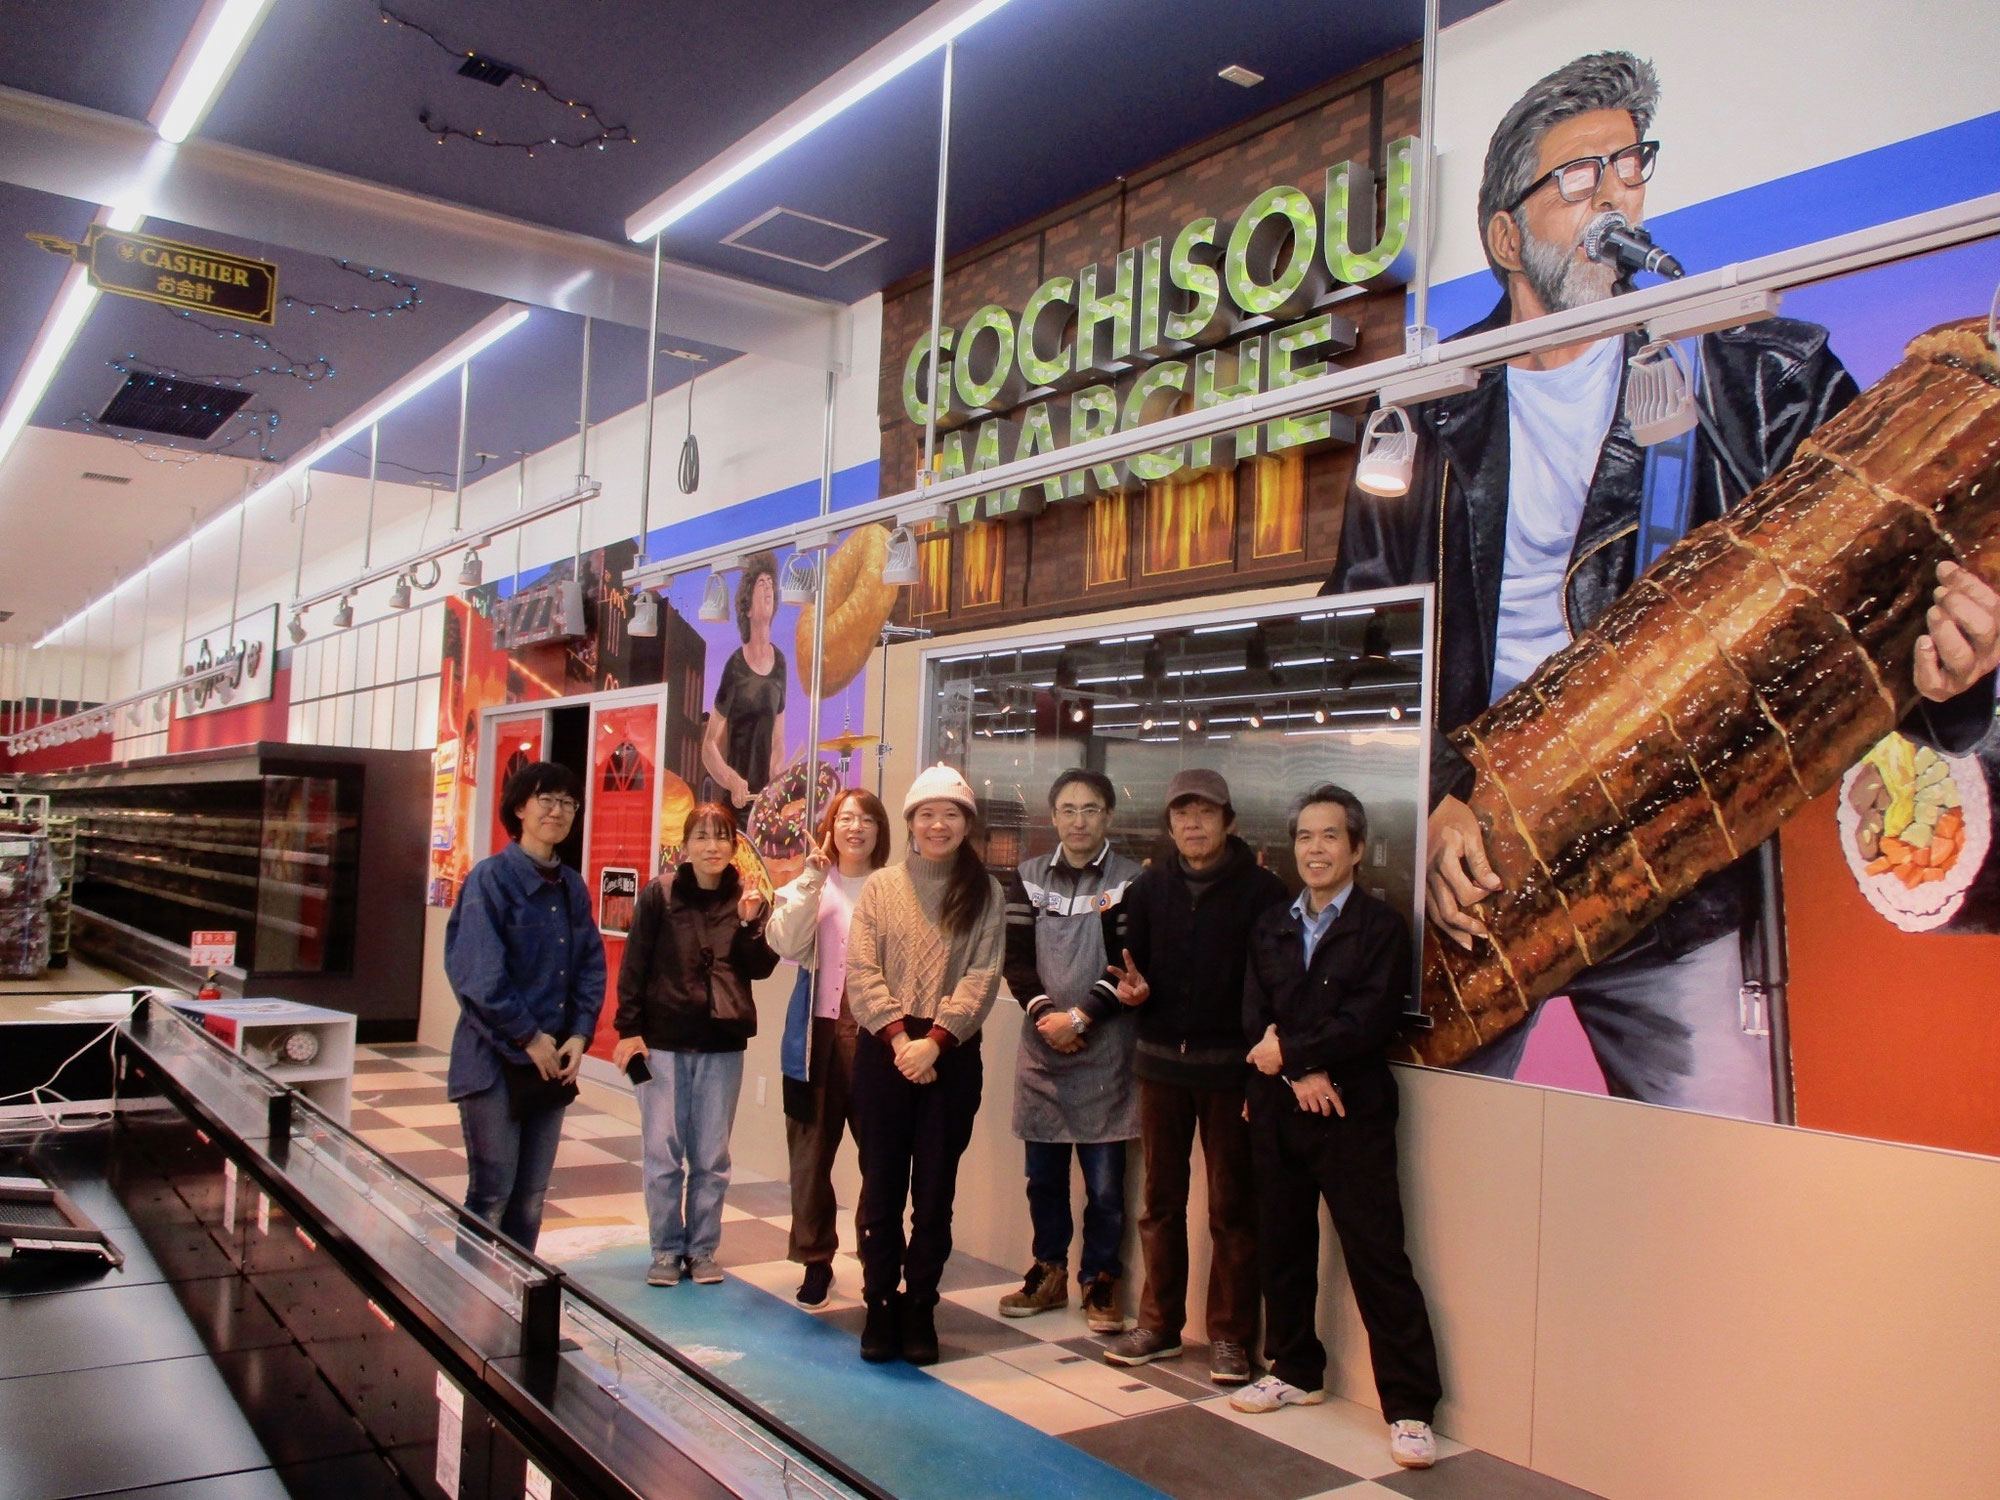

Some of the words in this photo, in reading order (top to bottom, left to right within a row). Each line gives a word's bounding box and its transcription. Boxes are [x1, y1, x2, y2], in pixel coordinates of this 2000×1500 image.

[139, 248, 250, 288] CASHIER
[156, 274, 216, 303] お会計
[902, 134, 1417, 425] GOCHISOU
[935, 313, 1350, 527] MARCHE
